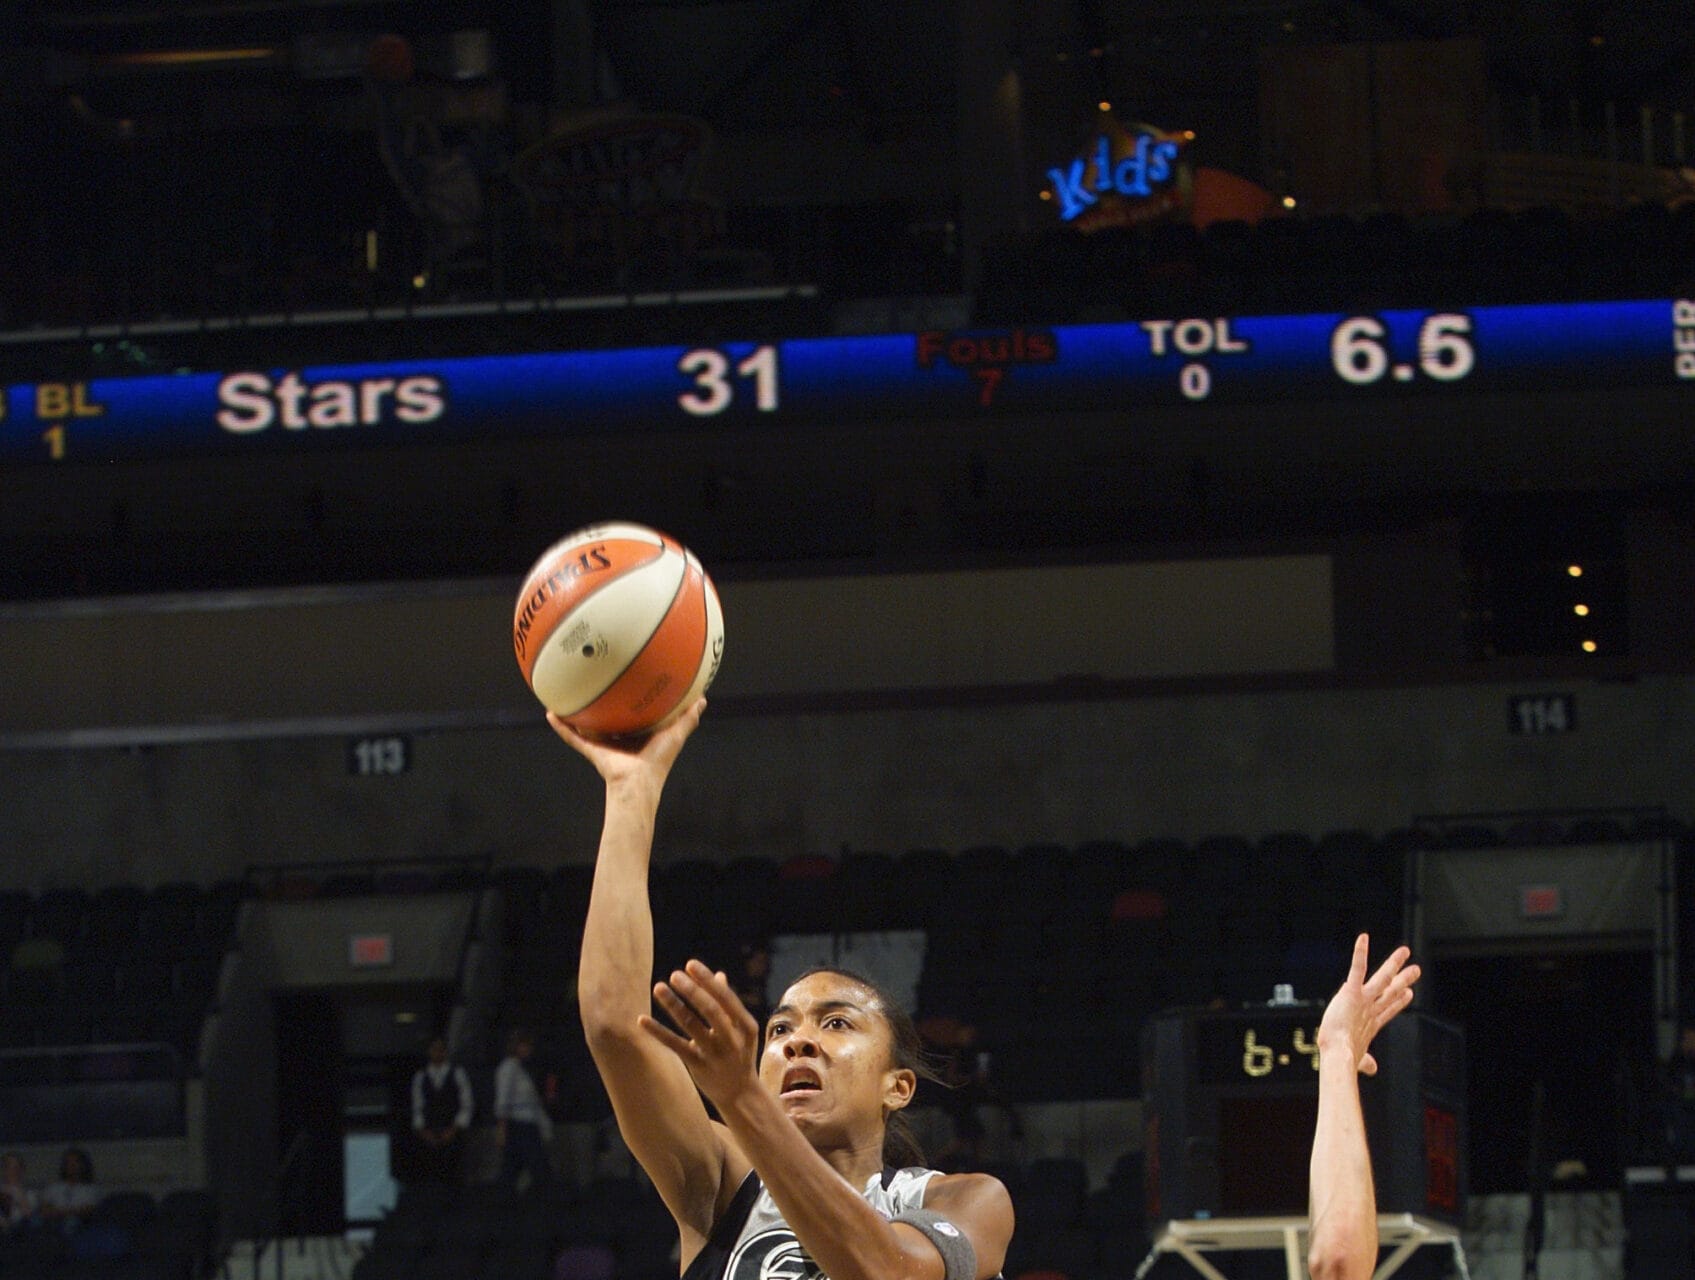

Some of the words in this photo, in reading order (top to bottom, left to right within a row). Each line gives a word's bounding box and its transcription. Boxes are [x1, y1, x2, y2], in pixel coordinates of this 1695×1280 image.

[1048, 133, 1178, 221] Kids
[916, 329, 1058, 368] Fouls
[1141, 317, 1248, 355] TOL
[679, 345, 780, 415] 31
[974, 367, 1001, 406] 7
[1180, 364, 1211, 400] 0
[36, 382, 104, 418] BL
[217, 372, 445, 432] Stars
[42, 424, 66, 460] 1
[515, 544, 611, 660] SPALDING
[356, 740, 404, 775] 113
